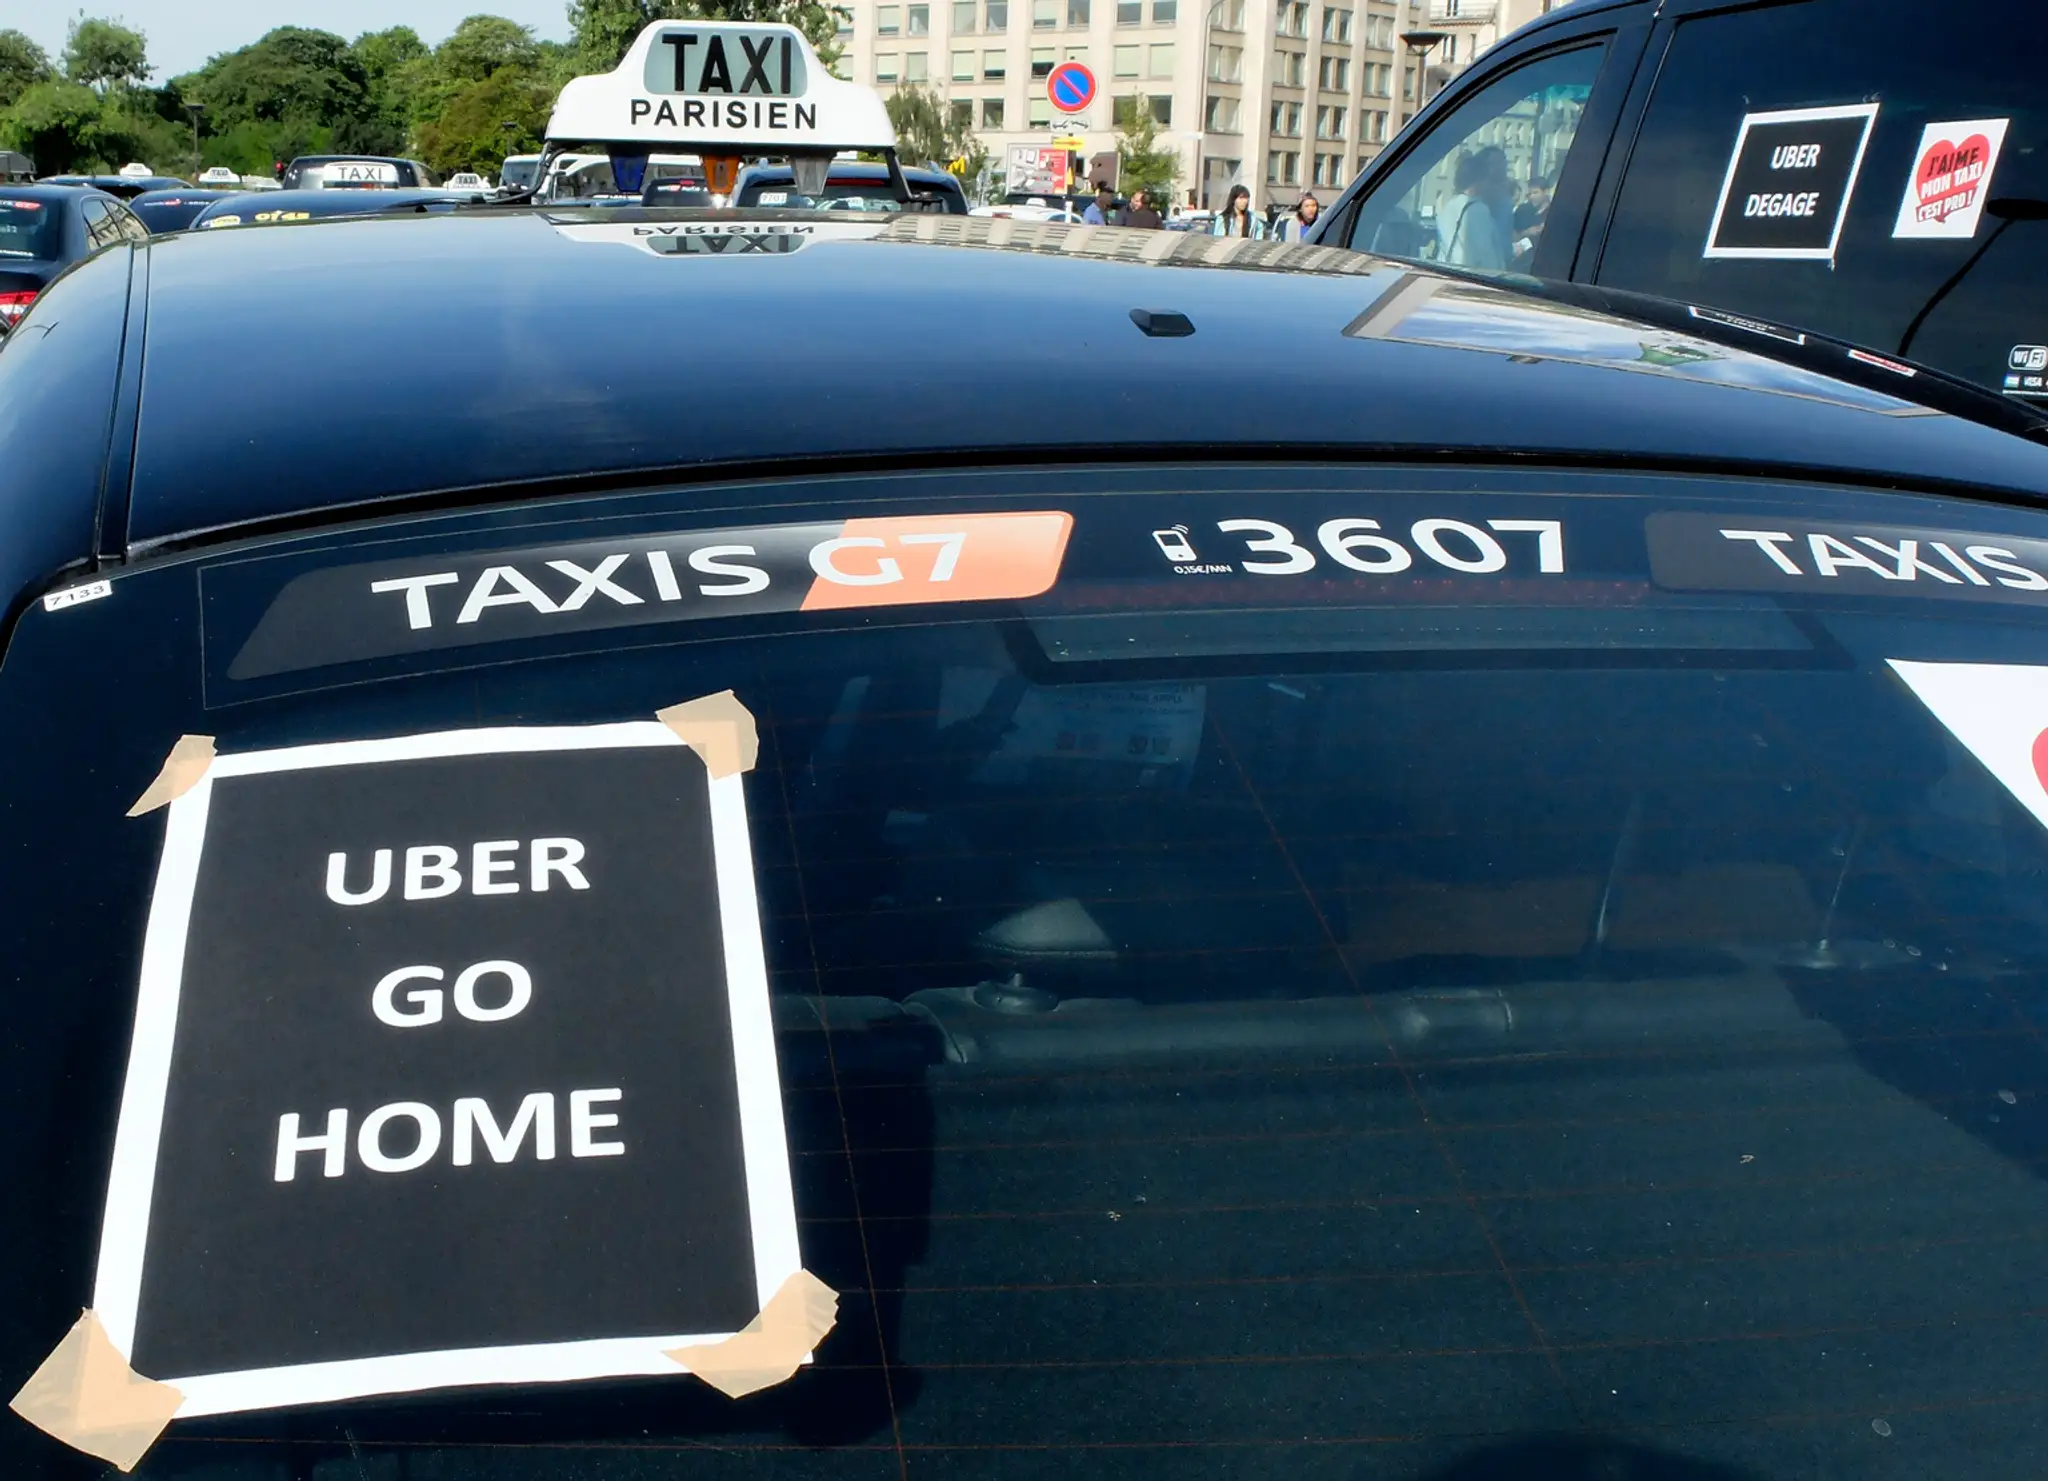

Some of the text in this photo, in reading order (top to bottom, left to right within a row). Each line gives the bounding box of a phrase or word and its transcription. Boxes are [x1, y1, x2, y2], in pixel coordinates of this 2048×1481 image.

[662, 34, 792, 94] TAXI
[631, 99, 816, 129] PARISIEN
[338, 166, 383, 180] TAXI
[1771, 144, 1820, 169] UBER
[1927, 147, 1980, 177] J'AIME
[1921, 161, 1983, 199] MON TAXI
[1744, 192, 1819, 216] DEGAGE
[1919, 200, 1943, 221] C'EST
[1216, 518, 1564, 575] 3607
[1719, 529, 2048, 591] TAXIS
[50, 585, 104, 605] 7133
[371, 532, 966, 630] TAXIS G7
[325, 837, 591, 906] UBER
[371, 959, 533, 1028] GO
[273, 1087, 626, 1183] HOME
